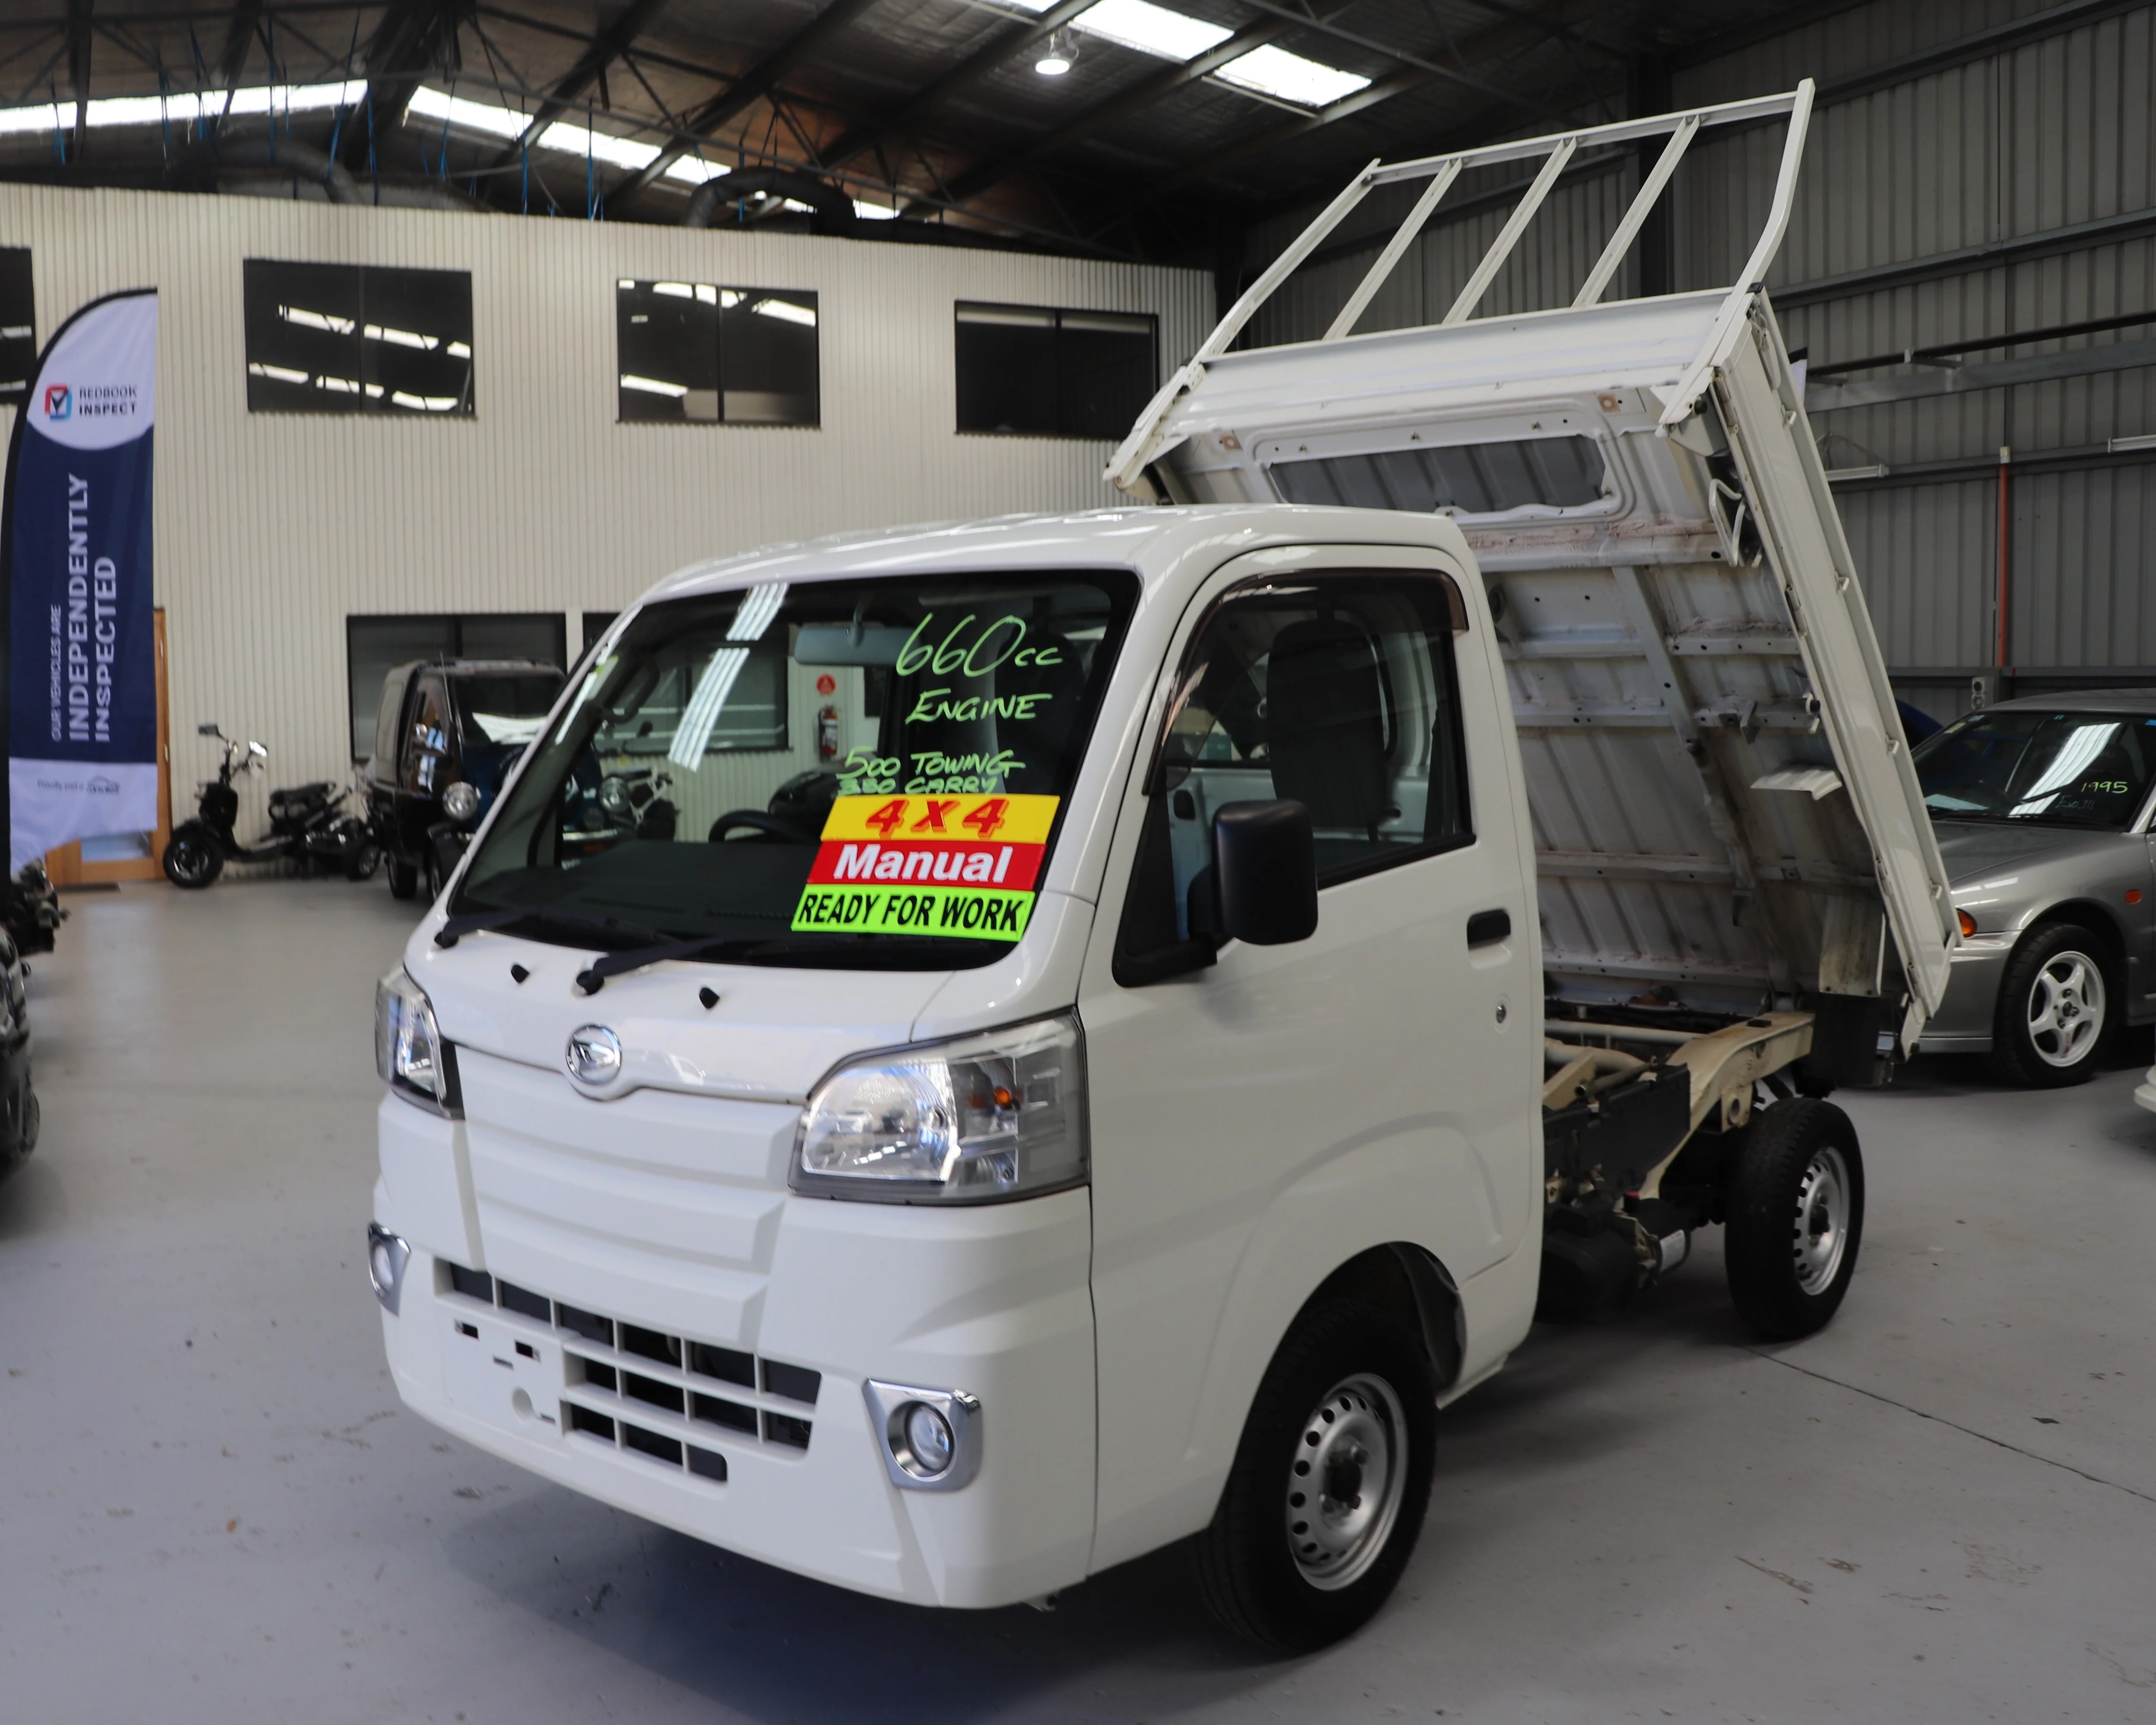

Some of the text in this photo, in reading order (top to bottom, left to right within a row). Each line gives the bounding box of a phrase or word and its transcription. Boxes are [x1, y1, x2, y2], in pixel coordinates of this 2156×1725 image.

[79, 384, 137, 399] REDBOOK
[79, 401, 136, 416] INSPECT
[69, 472, 89, 741] INDEPENDENTLY
[94, 556, 116, 742] INSPECTED
[906, 689, 1052, 724] ENGINE
[836, 746, 1027, 779] 500 TOWING
[904, 775, 998, 795] CARRY
[2081, 781, 2128, 794] 1995
[833, 843, 1013, 883] Manual
[798, 894, 1023, 931] READY FOR WORK
